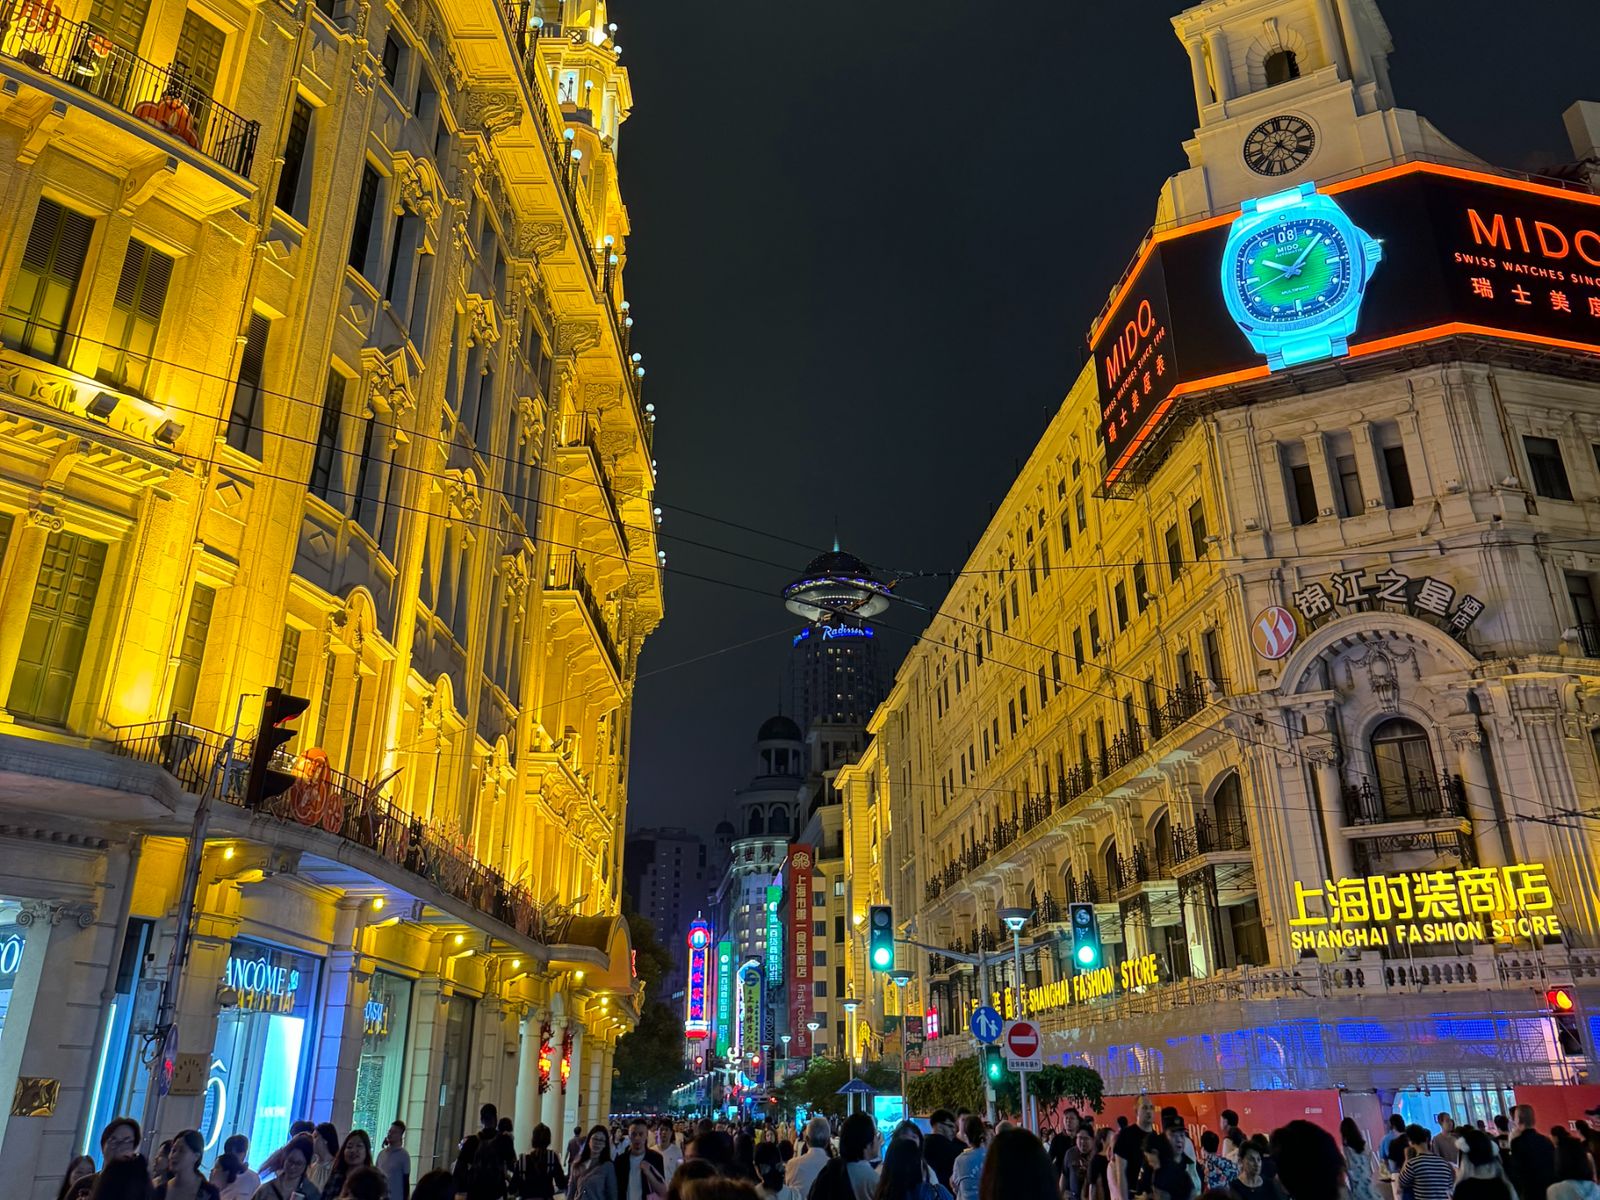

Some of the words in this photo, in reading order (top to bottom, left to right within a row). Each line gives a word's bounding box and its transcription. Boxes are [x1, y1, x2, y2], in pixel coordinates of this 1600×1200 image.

[1277, 243, 1299, 253] MIDO
[1278, 229, 1294, 243] 08
[1467, 208, 1600, 267] MIDO
[1454, 252, 1496, 268] SWISS
[1502, 261, 1565, 281] WATCHES
[1104, 398, 1117, 420] SWISS
[1116, 366, 1138, 400] WATCHES
[1137, 344, 1152, 369] SINCE
[822, 623, 865, 640] Radisson
[1289, 863, 1554, 927] 上海时装商店
[1291, 926, 1389, 950] SHANGHAI
[1396, 921, 1482, 946] FASHION
[1492, 914, 1561, 939] STORE
[226, 956, 287, 996] ANCÔME
[797, 984, 807, 1002] First
[1029, 978, 1070, 1012] SHANGHAI
[1074, 967, 1115, 1001] FASHION
[1121, 954, 1159, 988] STORE
[797, 1004, 807, 1048] Foodhall
